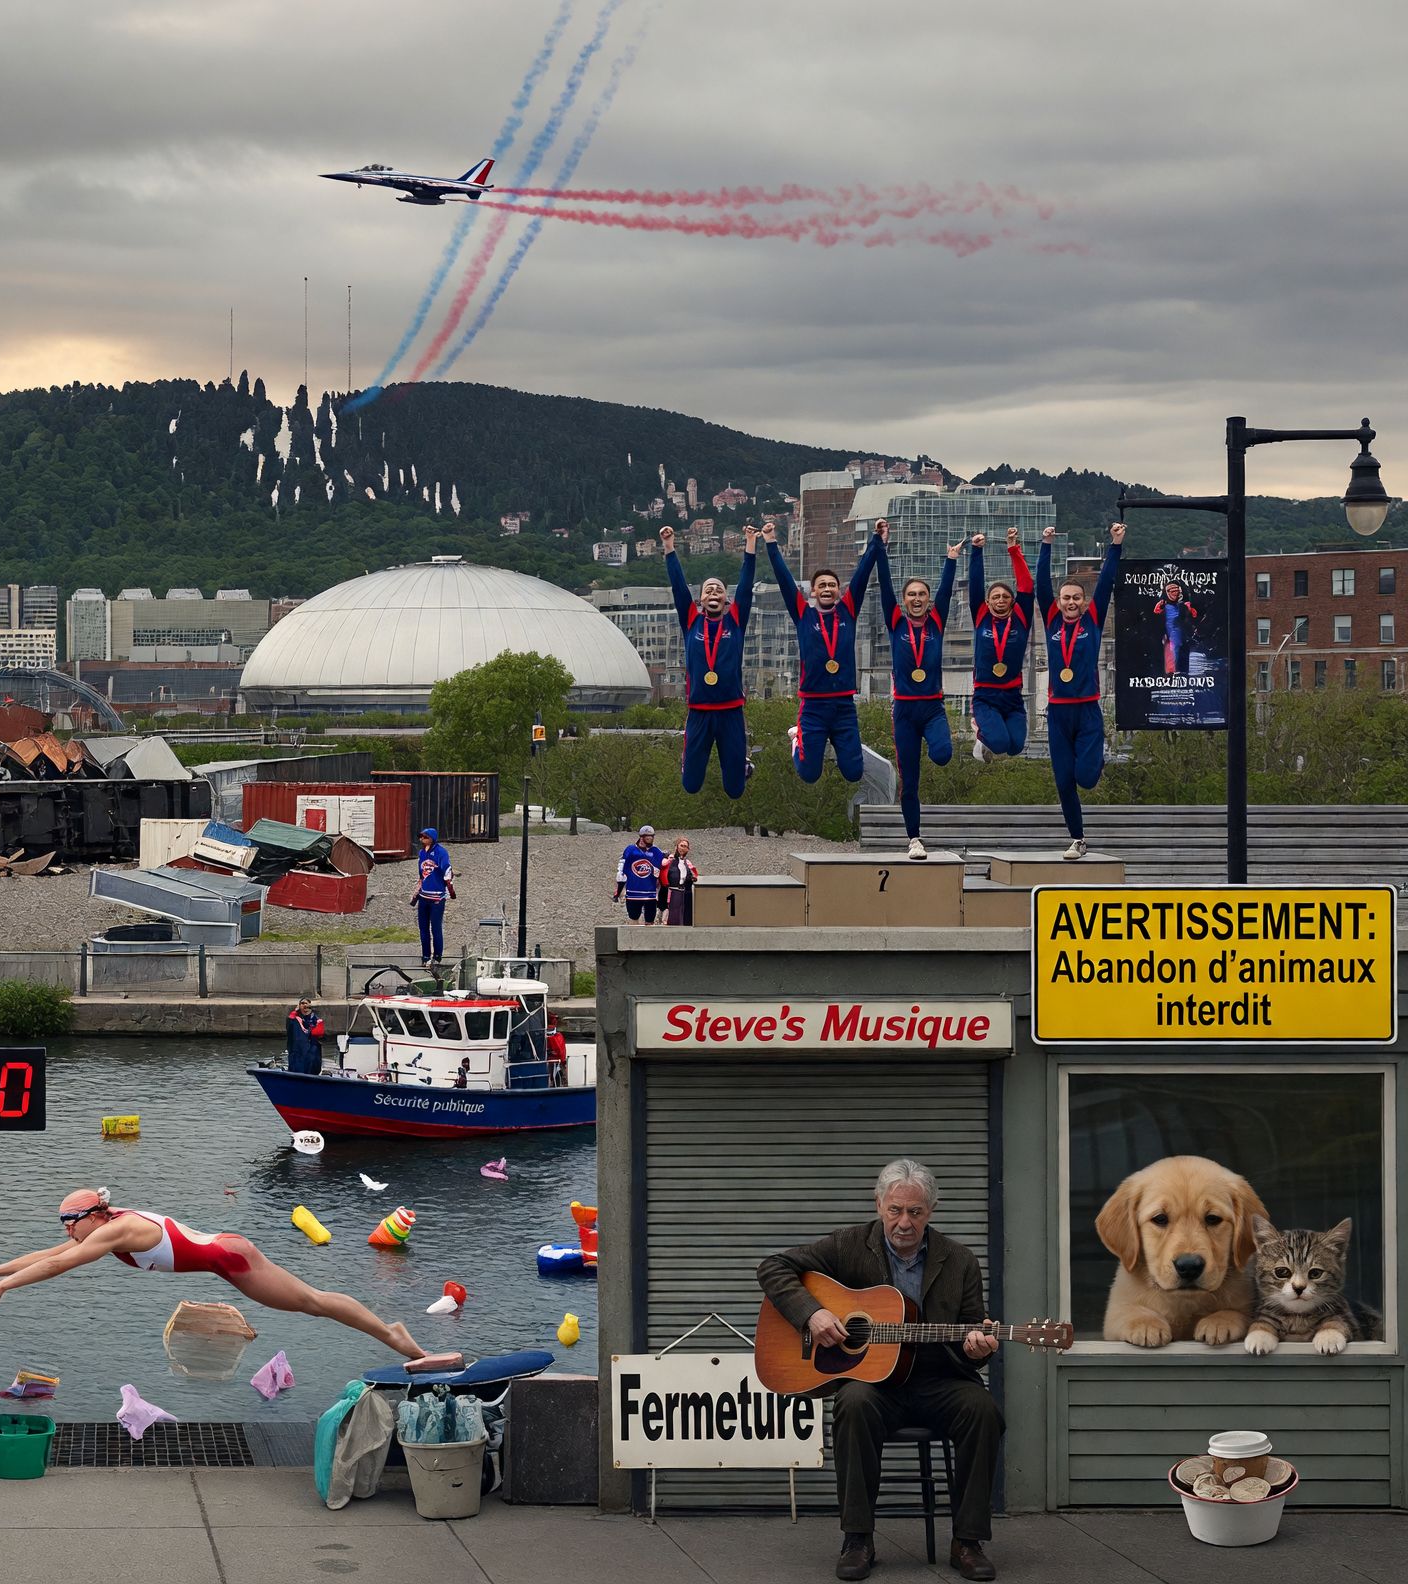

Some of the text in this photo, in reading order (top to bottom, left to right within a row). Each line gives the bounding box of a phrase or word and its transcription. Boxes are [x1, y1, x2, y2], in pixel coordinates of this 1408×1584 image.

[726, 893, 736, 917] 1
[1050, 902, 1376, 941] AVERTISSEMENT:
[1051, 949, 1376, 983] Abandon d'animaux
[1156, 992, 1272, 1026] interdit
[662, 1004, 991, 1049] Steve's Musique
[373, 1093, 430, 1110] Sécurité
[620, 1373, 815, 1441] Fermeture
